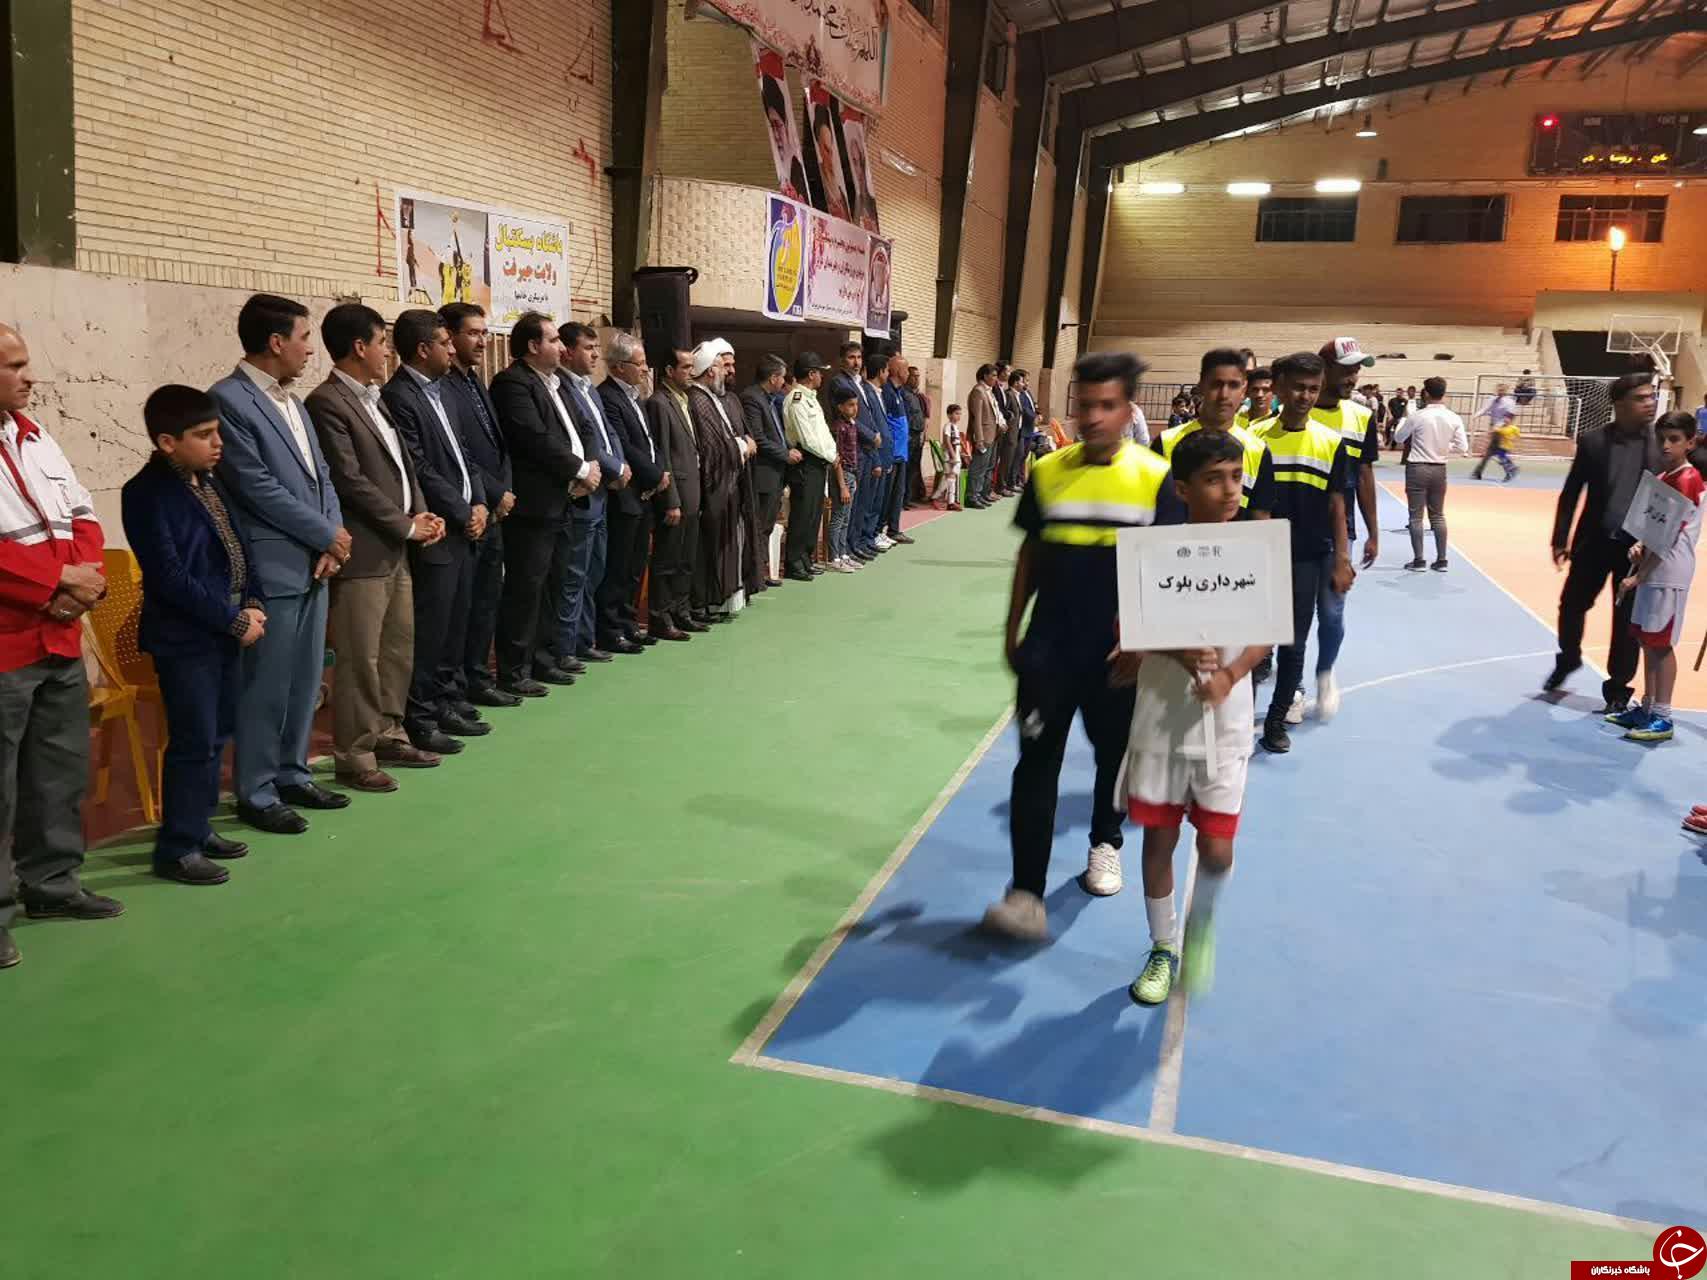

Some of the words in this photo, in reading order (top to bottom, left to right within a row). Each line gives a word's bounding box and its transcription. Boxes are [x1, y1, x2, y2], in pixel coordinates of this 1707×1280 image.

[495, 223, 535, 255] بسکتبال
[536, 230, 563, 259] باشگاه
[534, 262, 557, 286] ولایت
[1158, 575, 1192, 592] بلوک
[1195, 572, 1256, 592] شهرداری
